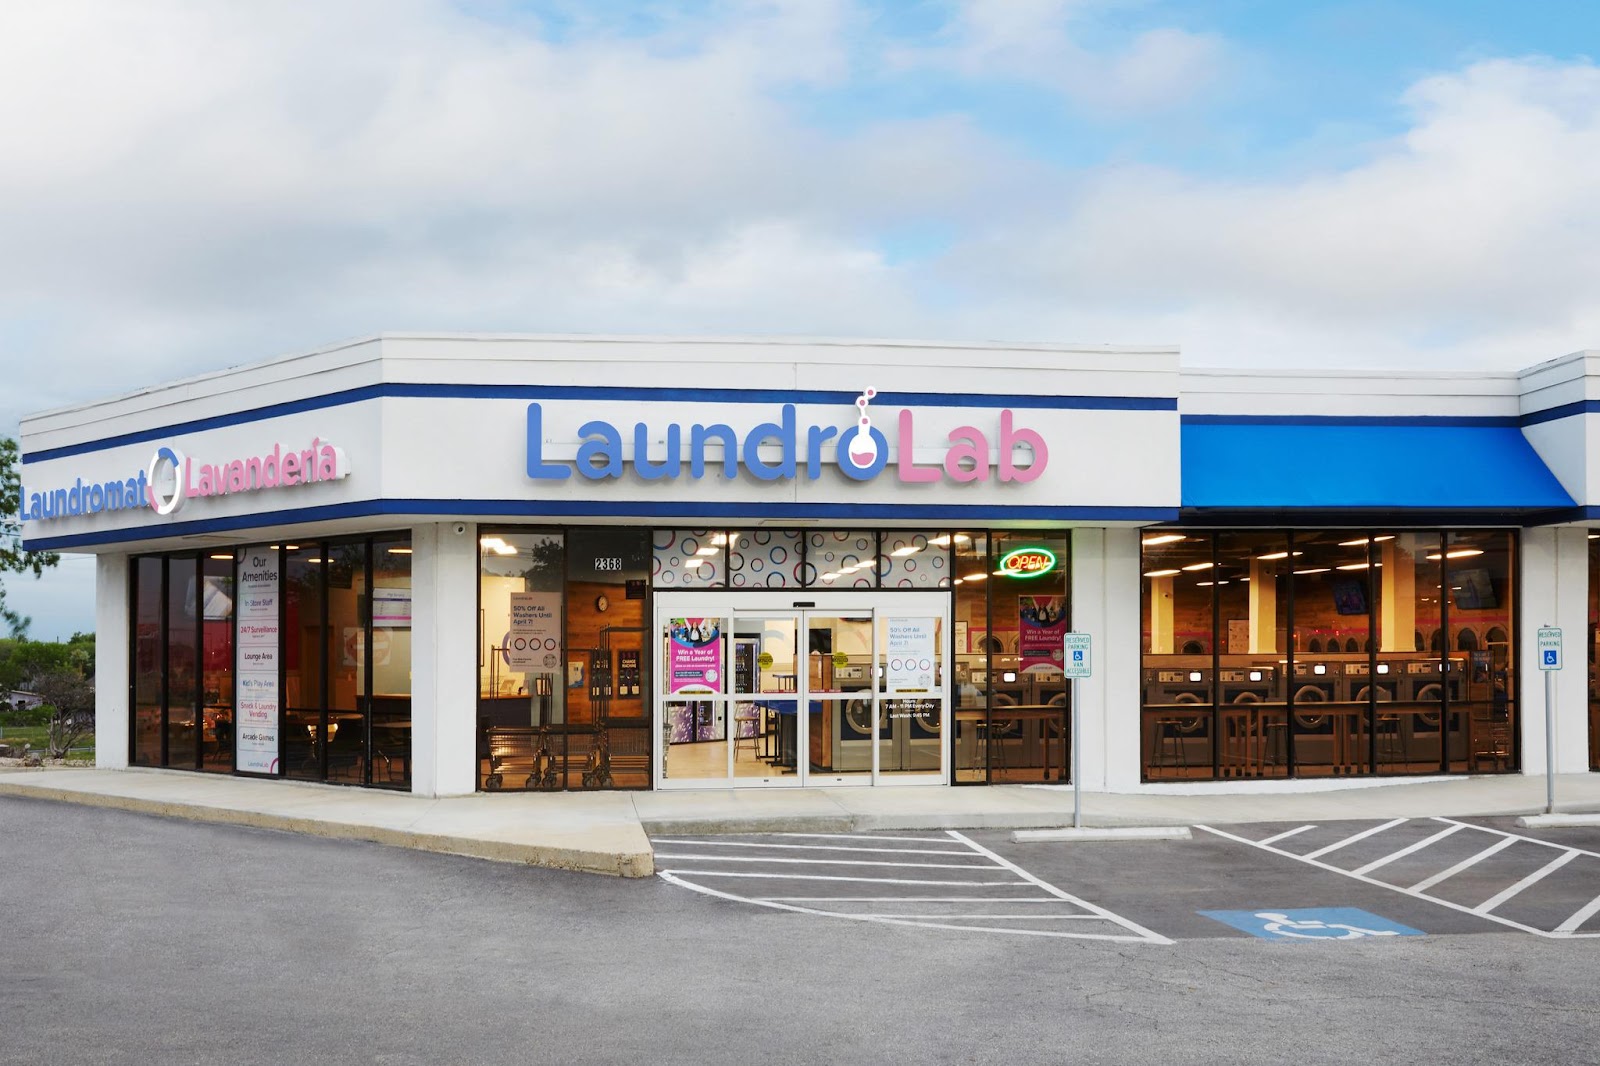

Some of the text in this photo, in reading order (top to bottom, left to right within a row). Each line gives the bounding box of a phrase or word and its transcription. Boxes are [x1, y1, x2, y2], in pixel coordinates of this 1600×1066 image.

[527, 394, 1048, 482] LaundroLab
[184, 437, 337, 498] Lavandería
[20, 469, 149, 521] Laundromat
[252, 556, 266, 568] Our
[595, 558, 621, 570] 2368
[1007, 555, 1048, 570] OPEN
[241, 570, 278, 582] Amenities
[251, 625, 278, 633] Surveillance
[889, 640, 903, 648] April
[244, 652, 273, 661] Lounge Area
[691, 655, 715, 663] Laundry!
[254, 680, 263, 688] Play
[240, 701, 253, 709] Snack
[259, 703, 277, 712] Laundry
[249, 710, 267, 719] Vending
[242, 732, 275, 742] Arcade Games
